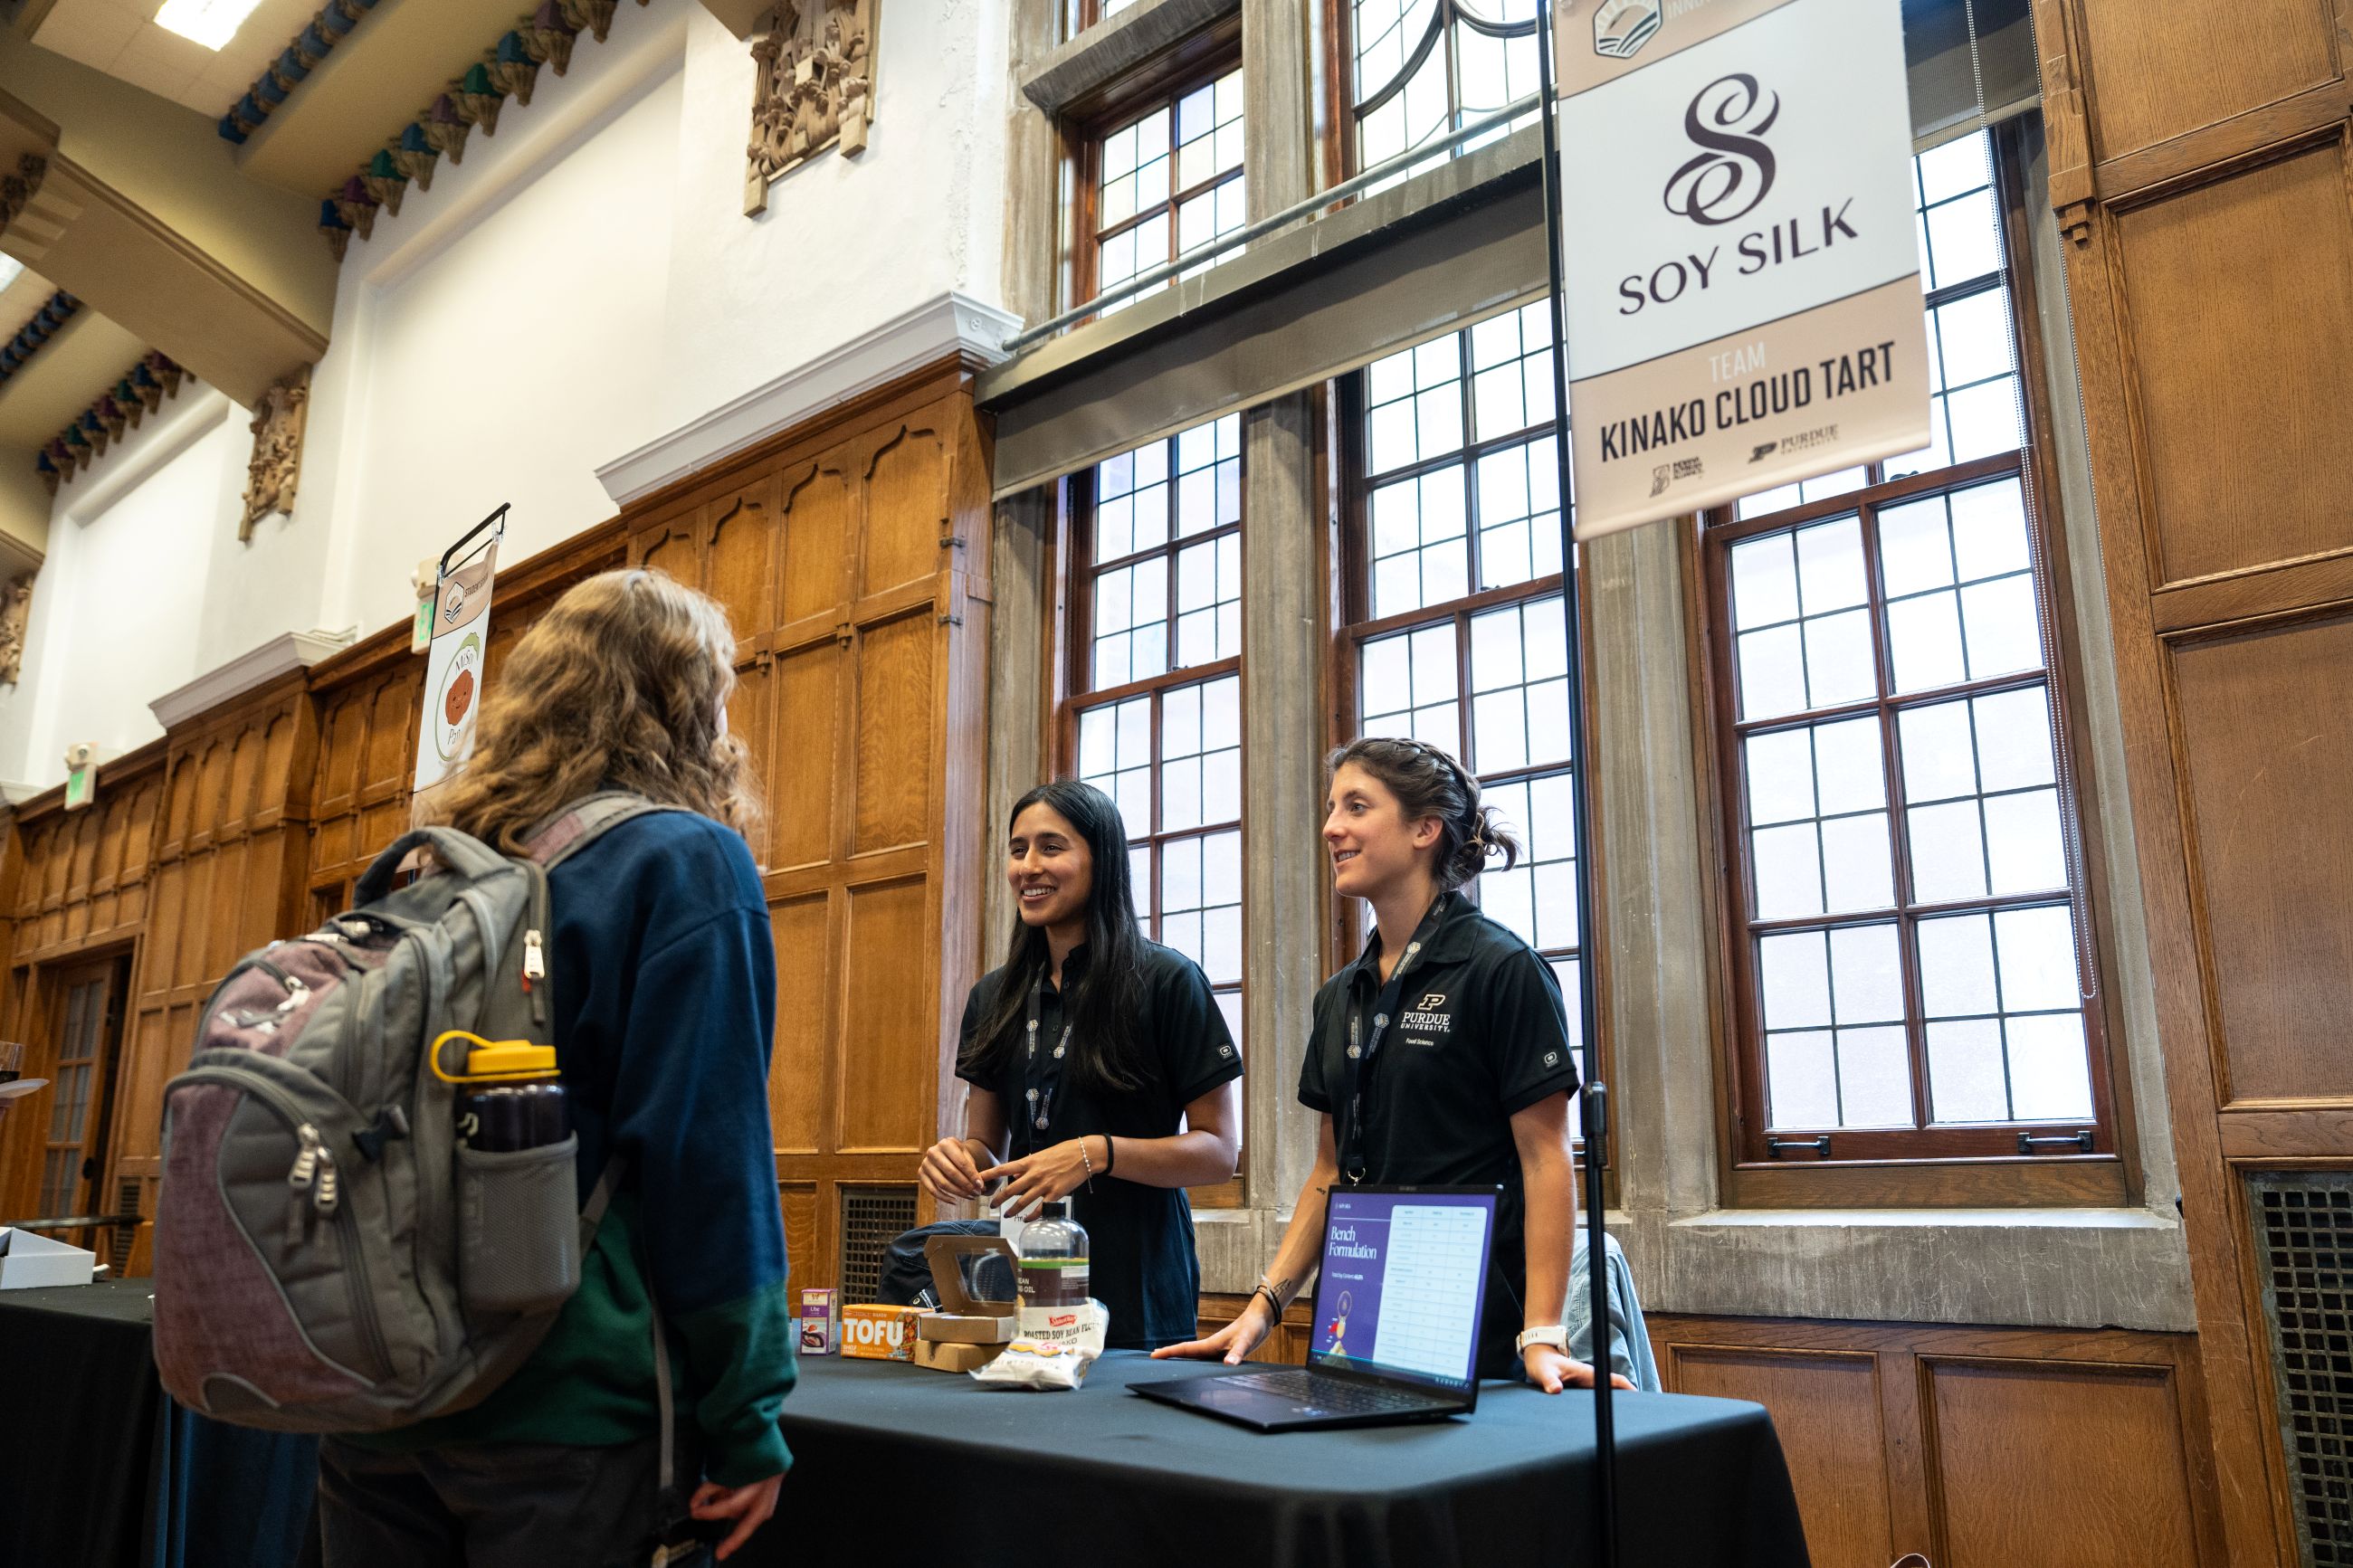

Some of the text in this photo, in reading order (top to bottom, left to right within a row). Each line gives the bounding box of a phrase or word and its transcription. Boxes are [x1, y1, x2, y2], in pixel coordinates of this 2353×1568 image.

[1619, 196, 1858, 315] SOY SILK
[1710, 341, 1766, 383] TEAM
[1600, 340, 1896, 462] KINAKO CLOUD TART
[1781, 423, 1838, 449] PURDUE
[1400, 1022, 1449, 1032] UNIVERSITY
[1402, 1012, 1451, 1026] PURDUE
[1417, 1038, 1434, 1047] Science
[1330, 1225, 1356, 1242] Bench
[1329, 1241, 1377, 1259] Formulation
[1024, 1286, 1036, 1294] OIL
[843, 1317, 904, 1347] TOFU
[1024, 1330, 1051, 1340] ROASTED
[1052, 1329, 1065, 1339] SOY
